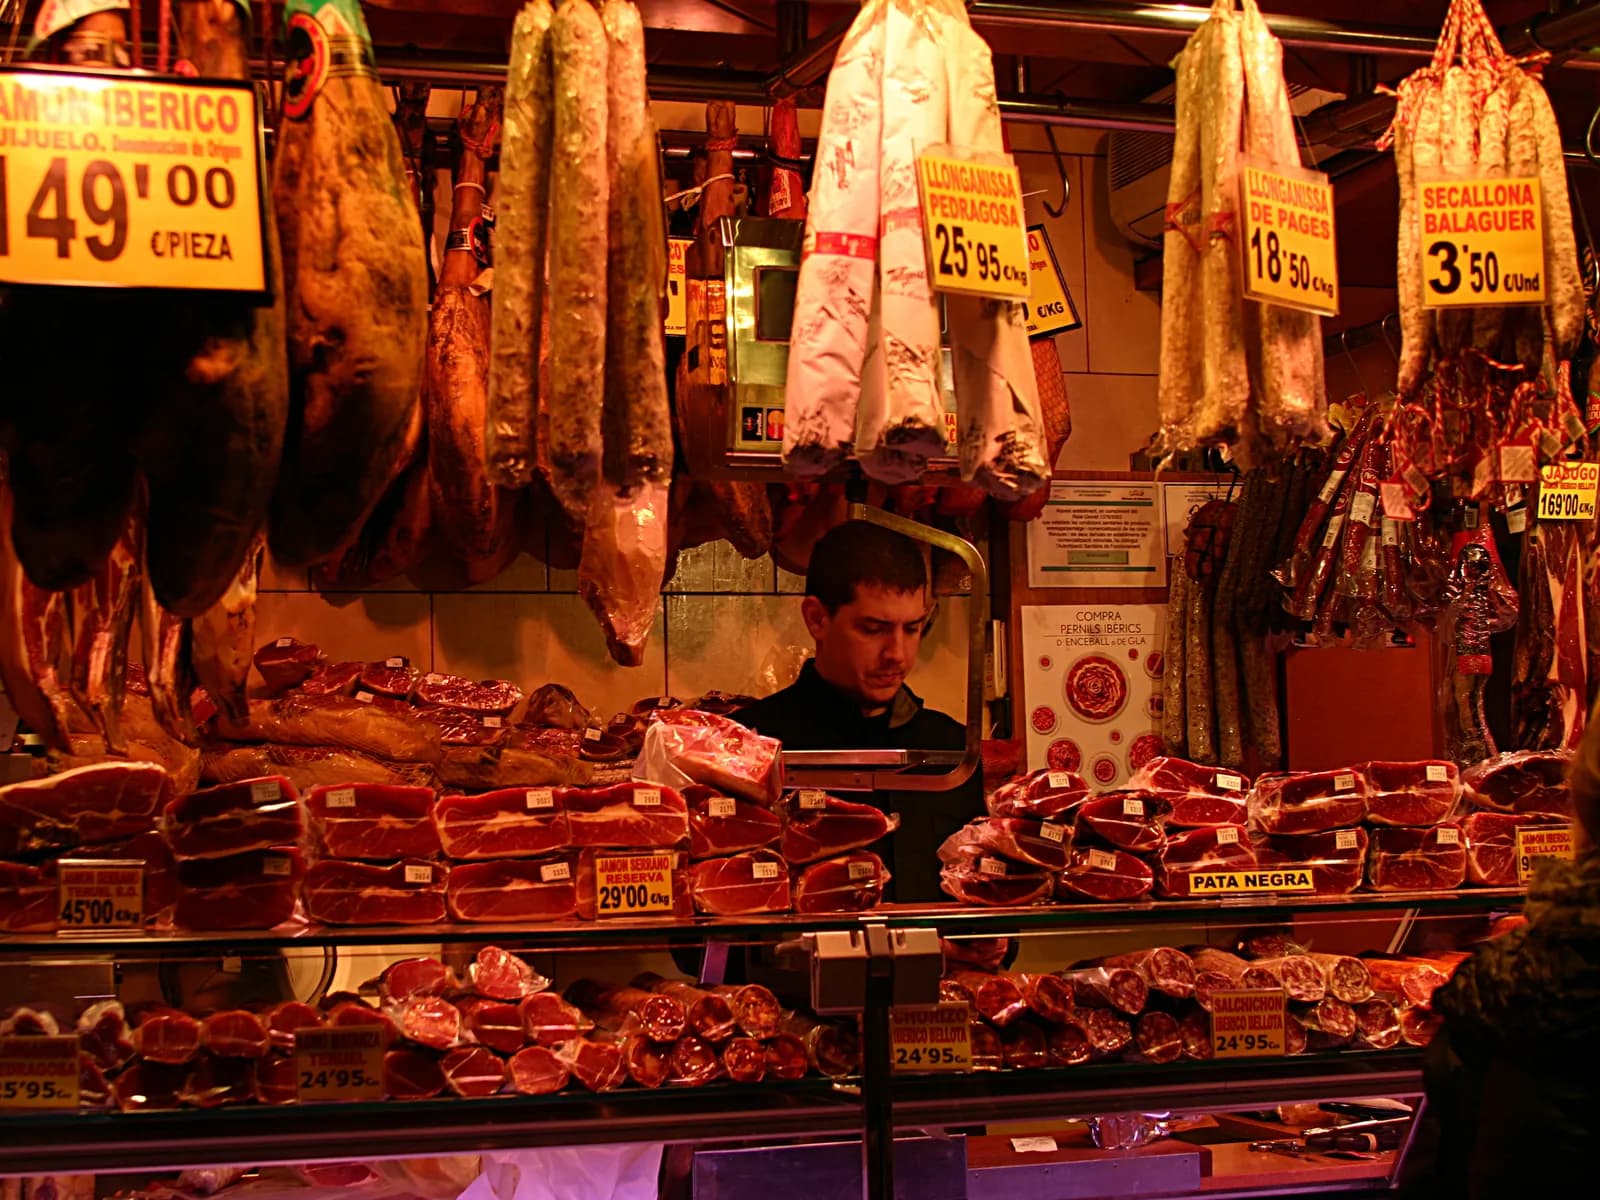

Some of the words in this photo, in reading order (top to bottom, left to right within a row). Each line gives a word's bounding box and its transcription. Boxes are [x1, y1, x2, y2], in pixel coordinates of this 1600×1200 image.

[103, 88, 240, 134] IBERICO
[925, 159, 1017, 199] LLONGANISSA
[1249, 170, 1329, 216] LLONGANISSA
[1423, 183, 1535, 209] SECALLONA
[929, 193, 1020, 228] PEDRAGOSA
[1250, 201, 1273, 226] DE
[1278, 207, 1331, 240] PAGES
[1424, 209, 1536, 234] BALAGUER
[1541, 493, 1579, 516] 169'00
[1060, 623, 1101, 634] PERNILS
[1075, 611, 1122, 622] COMPRA
[1525, 844, 1571, 854] BELLOTA
[599, 859, 628, 872] JAMON
[630, 856, 669, 871] SERRANO
[606, 872, 664, 884] RESERVA
[1194, 874, 1239, 889] PATA
[1244, 872, 1310, 887] NEGRA
[600, 884, 648, 909] 29'00
[62, 899, 113, 924] 45'00
[1214, 996, 1283, 1012] SALCHICHON
[0, 1081, 56, 1098] 5'95
